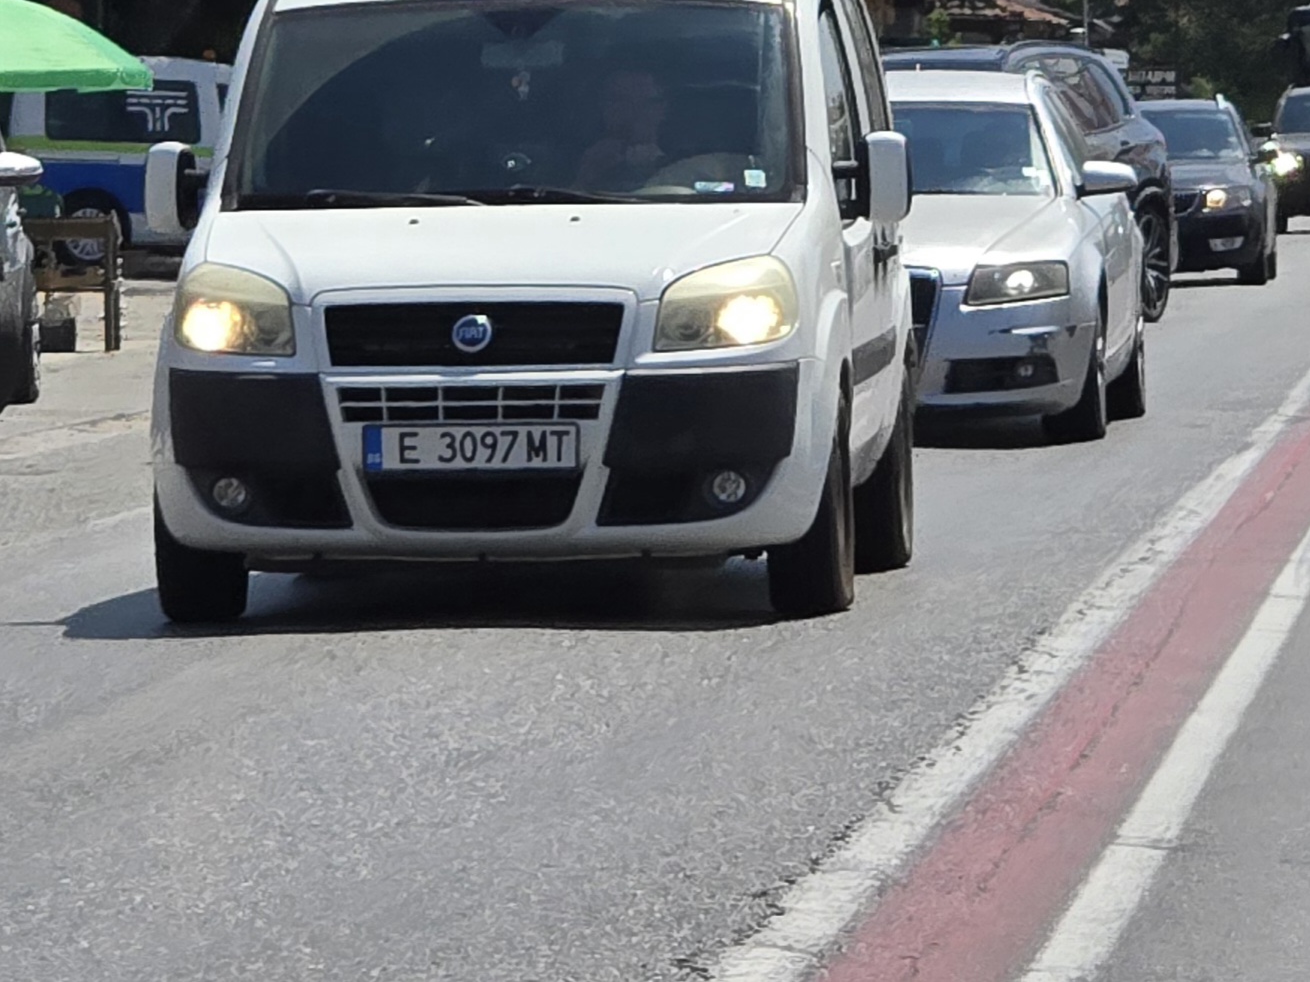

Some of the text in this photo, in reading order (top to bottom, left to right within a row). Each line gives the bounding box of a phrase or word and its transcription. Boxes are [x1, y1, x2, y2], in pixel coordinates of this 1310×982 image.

[399, 432, 421, 464] E
[437, 431, 519, 464] 3097
[526, 430, 570, 463] MT
